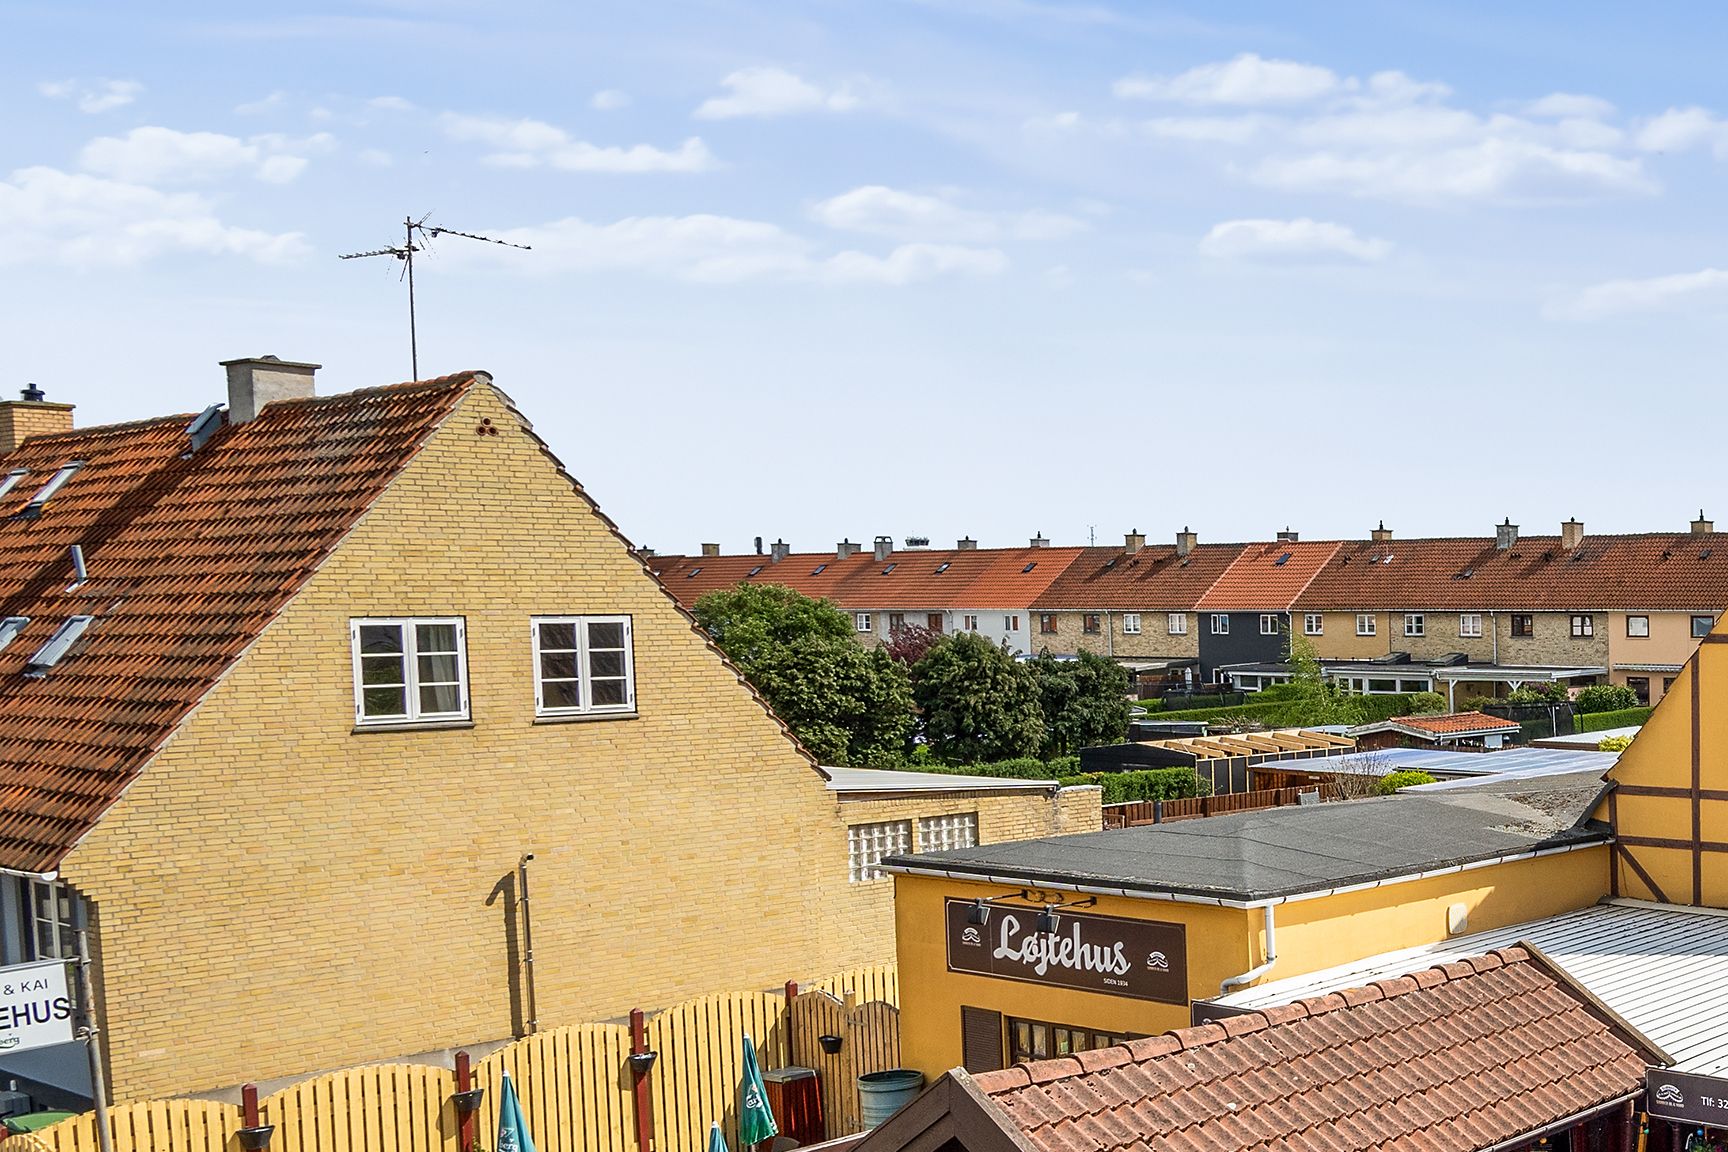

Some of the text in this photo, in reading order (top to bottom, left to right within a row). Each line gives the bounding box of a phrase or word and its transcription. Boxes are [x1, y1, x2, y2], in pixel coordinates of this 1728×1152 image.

[993, 914, 1131, 976] Løjtehus
[3, 978, 48, 995] & KAI
[1700, 1096, 1715, 1107] Tlf:
[1717, 1098, 1728, 1110] 32
